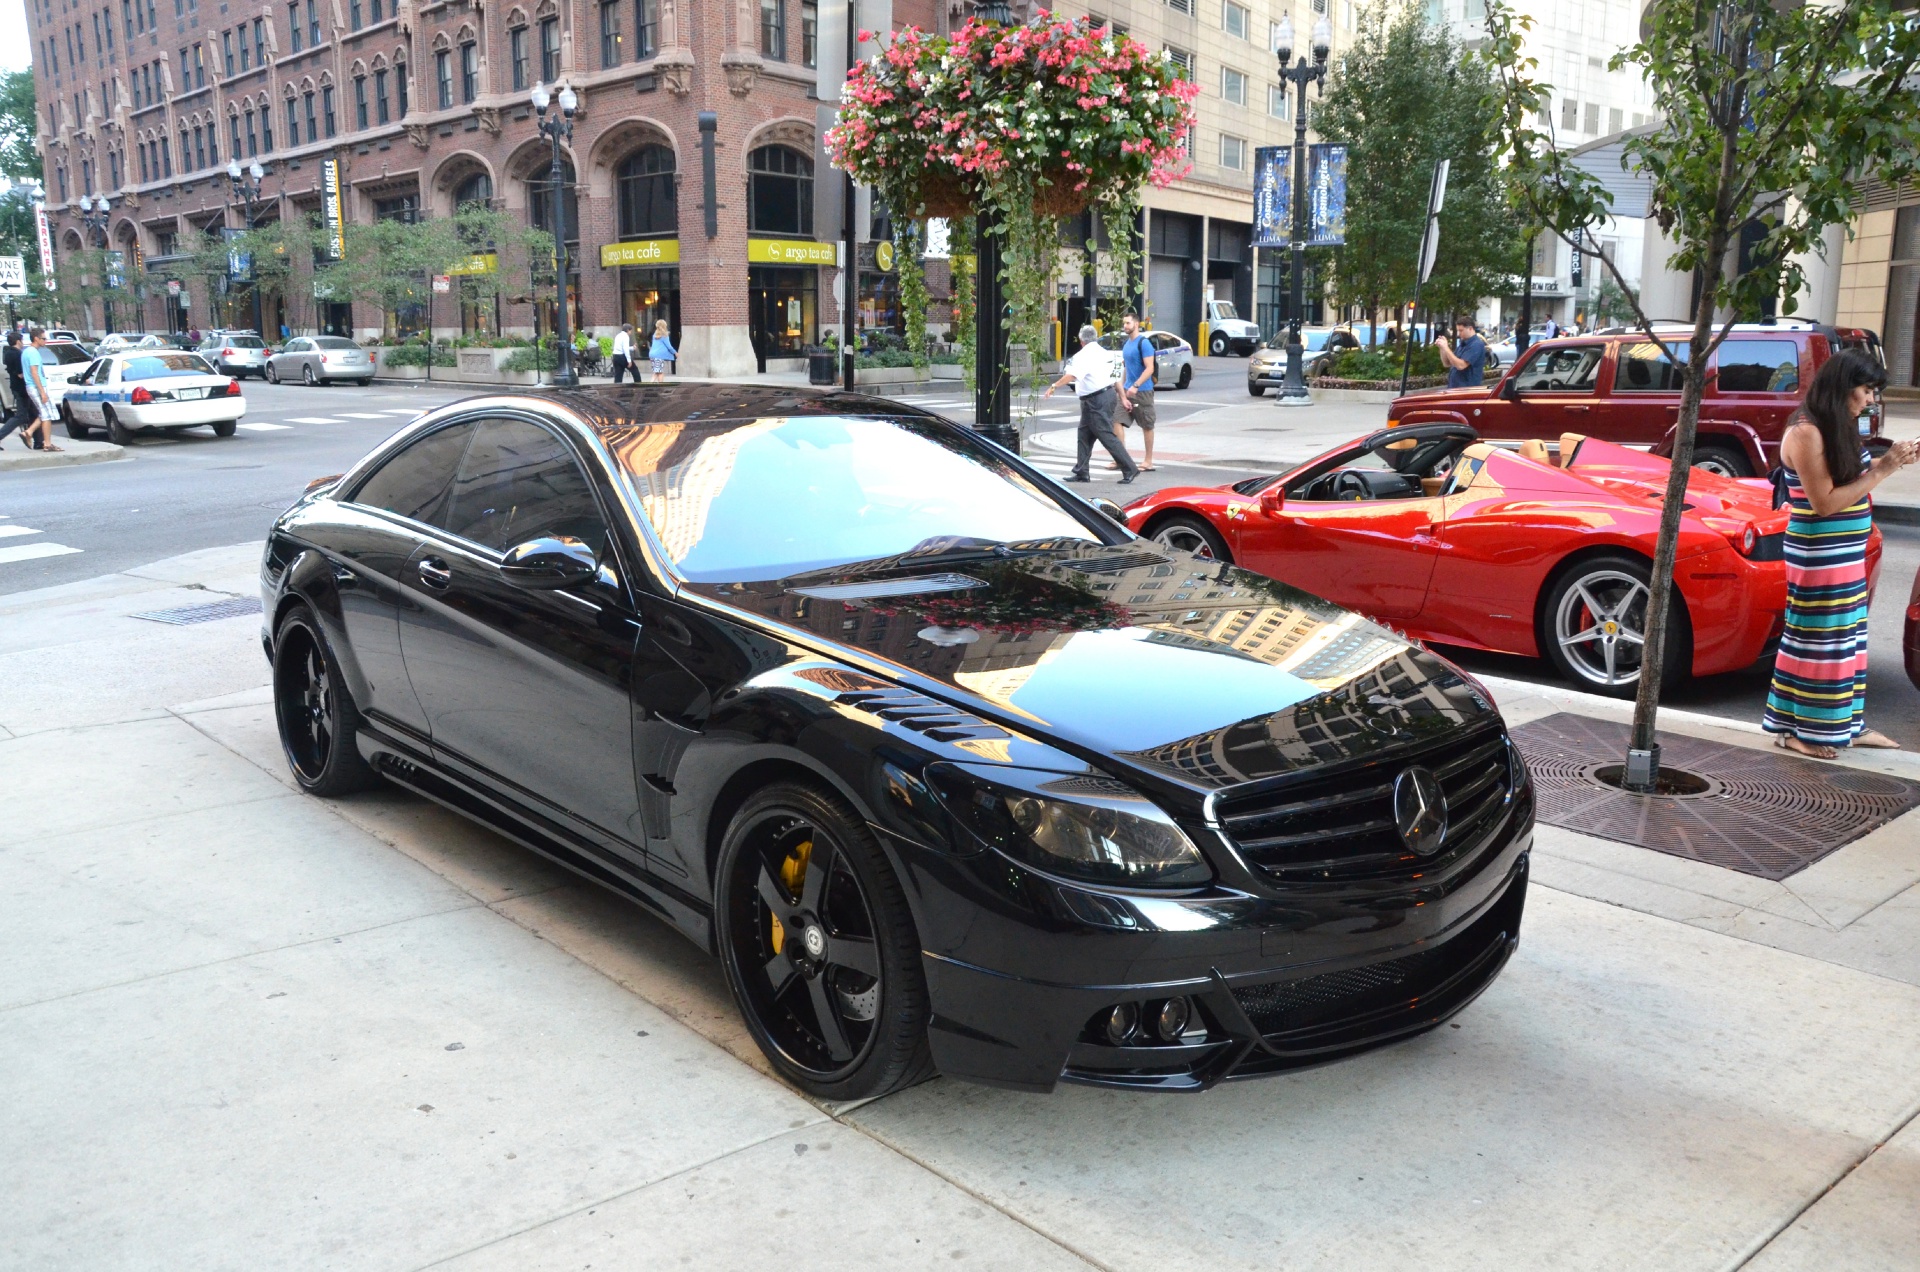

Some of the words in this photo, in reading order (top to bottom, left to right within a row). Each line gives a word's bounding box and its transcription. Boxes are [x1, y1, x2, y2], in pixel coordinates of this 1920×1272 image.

[324, 160, 336, 193] BAGELS
[1262, 162, 1275, 228] Cosmologies
[1317, 159, 1330, 226] Cosmologies
[1260, 234, 1281, 243] LUMA
[1314, 233, 1336, 242] LUMA
[608, 250, 620, 264] argo
[622, 248, 634, 260] tea
[636, 241, 661, 259] café
[785, 247, 807, 262] argo
[809, 247, 820, 259] tea
[1572, 251, 1582, 274] rack
